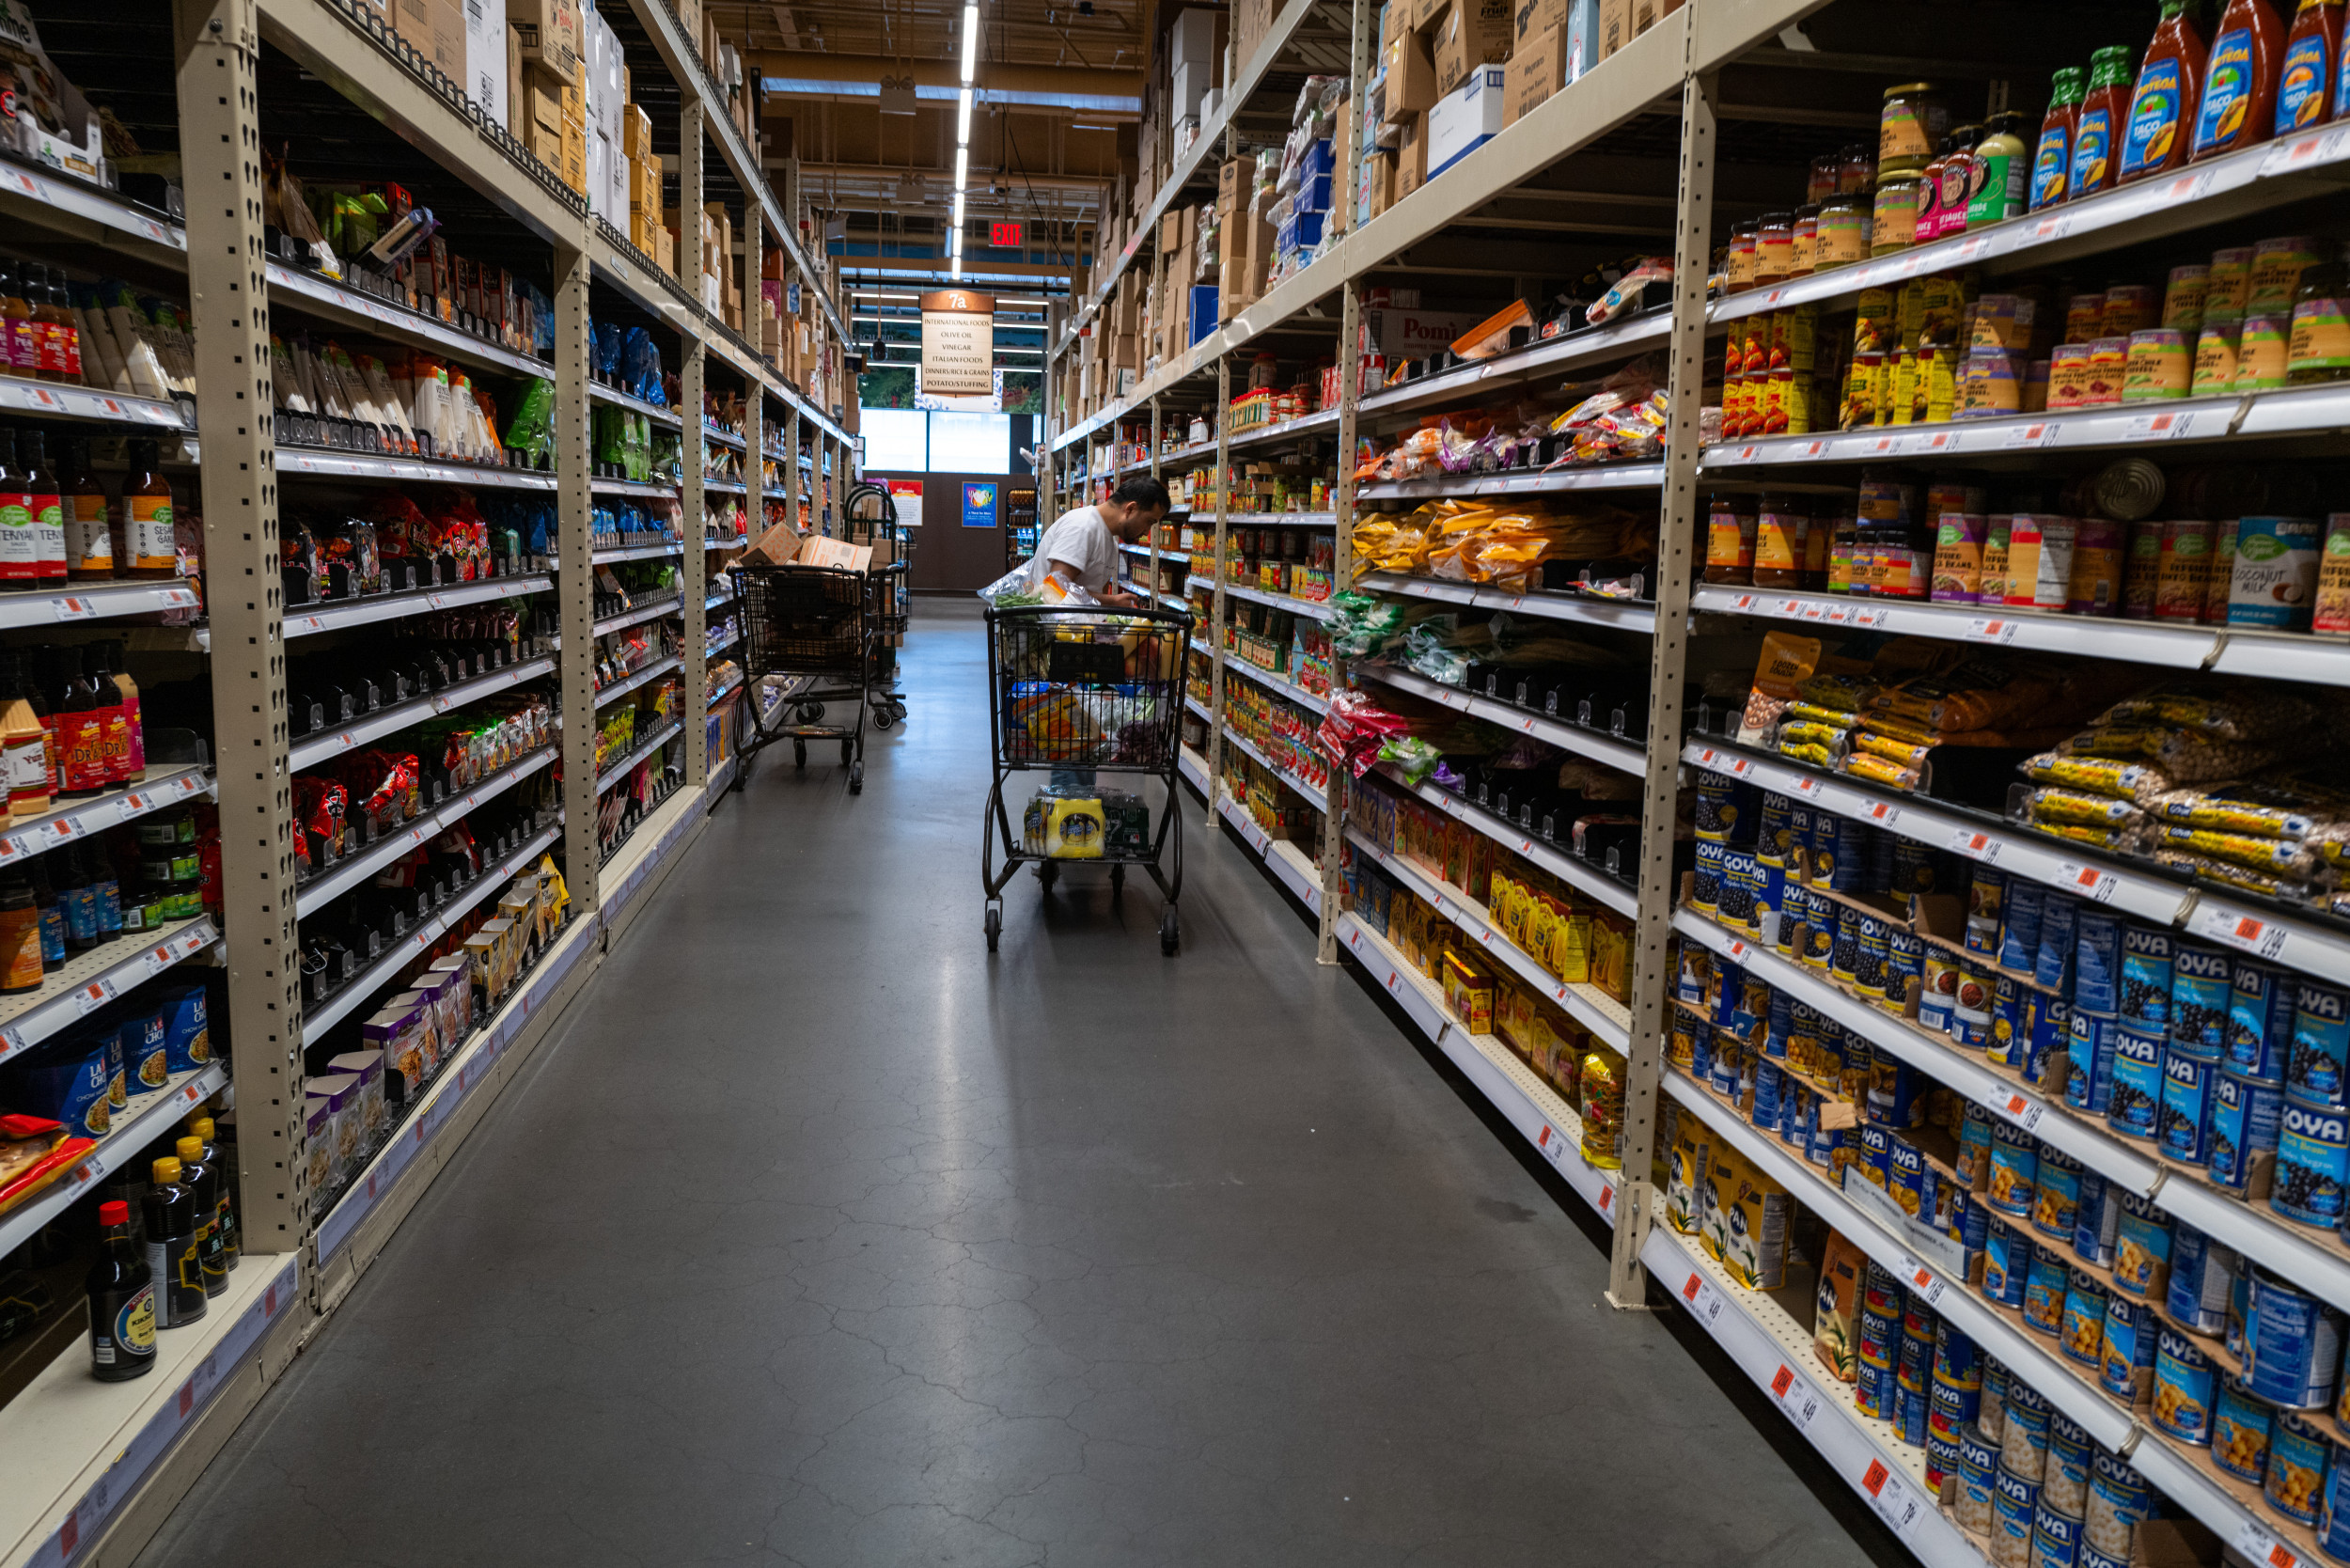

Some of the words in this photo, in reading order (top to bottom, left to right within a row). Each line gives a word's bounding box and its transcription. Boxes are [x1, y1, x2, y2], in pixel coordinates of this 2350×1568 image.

[1480, 6, 1508, 17] Fruit
[2210, 48, 2249, 69] ORTEGA
[2285, 50, 2321, 71] ORTEGA
[2136, 76, 2178, 100] ORTEGA
[2284, 89, 2307, 105] TACO
[2207, 94, 2232, 110] TACO
[2134, 120, 2160, 133] TACO
[1359, 180, 1370, 200] APPLE
[1947, 207, 1968, 222] SAUCE
[994, 224, 1021, 245] EXIT
[949, 293, 966, 308] 7a
[2235, 569, 2287, 586] COCONUT
[2242, 582, 2267, 593] MILK
[1764, 793, 1789, 810] OYA
[2168, 804, 2192, 817] GOYA
[1793, 811, 1808, 827] YA
[1817, 815, 1833, 832] YA
[2170, 827, 2193, 839] GOYA
[1724, 853, 1754, 871] GOY
[1753, 867, 1768, 883] YA
[1783, 885, 1808, 901] OYA
[1808, 897, 1832, 913] OYA
[1891, 933, 1923, 954] OYA
[2125, 930, 2169, 956] OYA
[2175, 950, 2229, 978] OYA
[2234, 966, 2257, 993] YA
[194, 1001, 204, 1014] LA
[1791, 1001, 1820, 1020] GOY
[194, 1011, 208, 1025] CHO
[1819, 1016, 1840, 1034] YA
[144, 1021, 157, 1034] LA
[2116, 1033, 2155, 1061] OYA
[89, 1062, 102, 1077] LA
[91, 1074, 106, 1089] CHO
[1862, 1126, 1886, 1149] YA
[1995, 1121, 2033, 1147] OYA
[1893, 1146, 1919, 1169] YA
[2041, 1144, 2080, 1169] OYA
[2123, 1192, 2166, 1222] OYA
[2070, 1268, 2103, 1292] GOY
[2108, 1295, 2130, 1321] YA
[1863, 1312, 1887, 1331] OYA
[1903, 1337, 1919, 1355] YA
[2159, 1330, 2204, 1364] OYA
[2051, 1413, 2089, 1444] OYA
[1960, 1438, 1990, 1467] OYA
[1997, 1469, 2028, 1501] OYA
[2034, 1505, 2068, 1539] OYA
